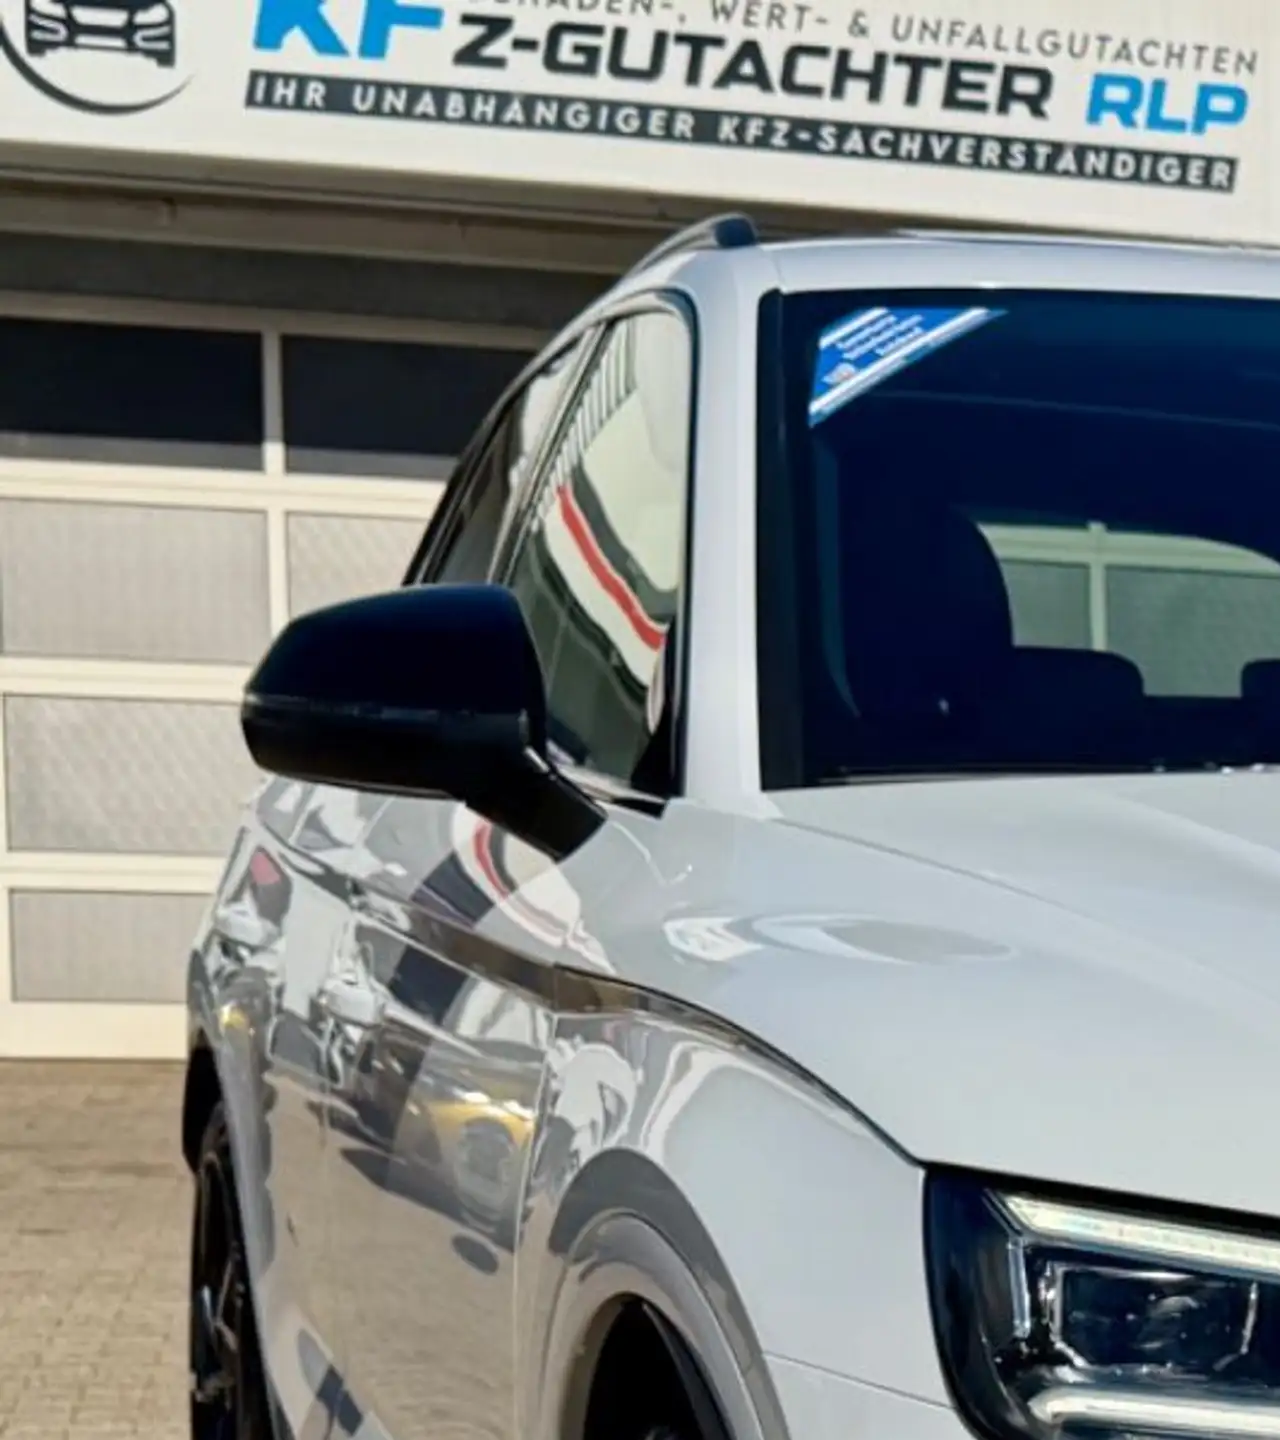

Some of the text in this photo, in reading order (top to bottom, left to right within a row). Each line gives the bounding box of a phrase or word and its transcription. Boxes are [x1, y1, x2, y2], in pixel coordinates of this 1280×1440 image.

[711, 0, 829, 32] WERT-
[847, 9, 870, 39] &
[891, 14, 1259, 76] UNFALLGUTACHTEN
[253, 75, 1233, 189] IHR UNABHÄNGIGER KFZ-SACHVERSTÄNDIGER
[1085, 72, 1249, 136] RLP
